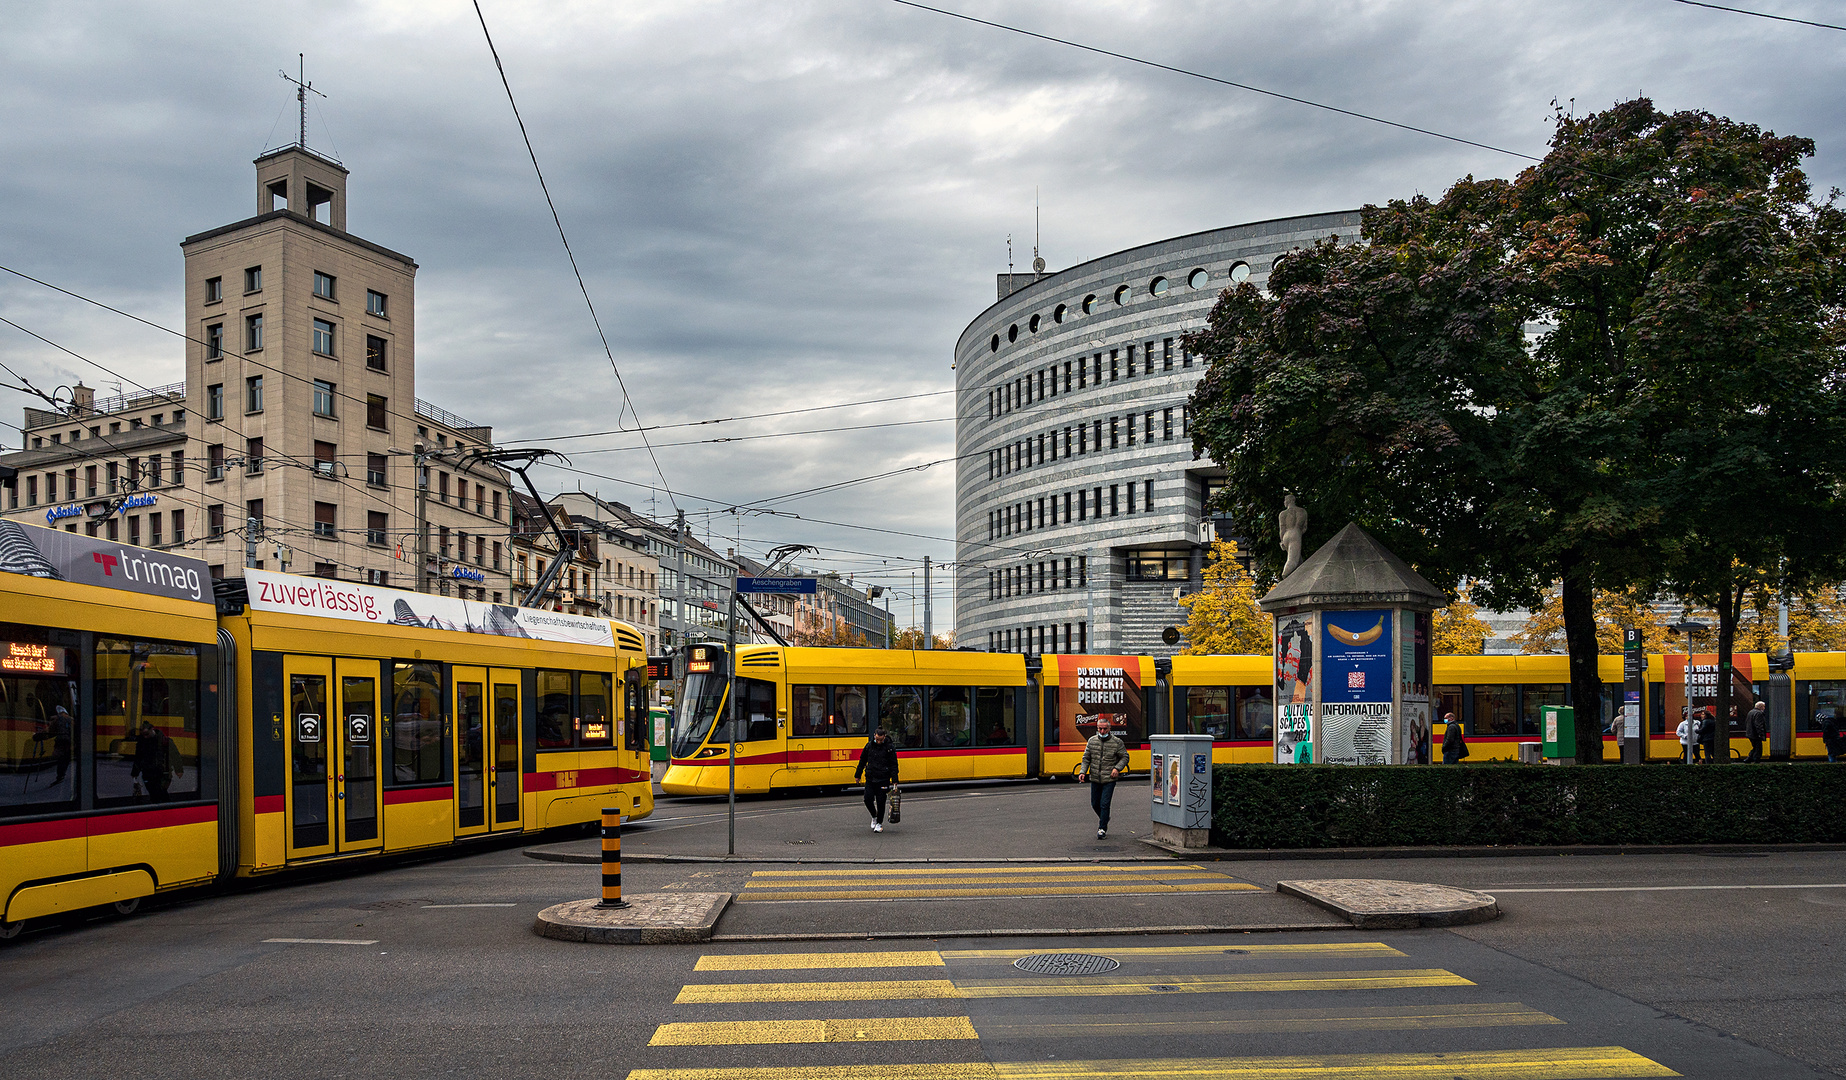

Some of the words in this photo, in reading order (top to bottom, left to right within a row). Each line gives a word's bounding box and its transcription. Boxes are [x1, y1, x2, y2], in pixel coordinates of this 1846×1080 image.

[128, 492, 157, 508] Basler
[56, 503, 83, 519] Basler
[120, 549, 201, 601] trimag
[463, 566, 485, 582] Basler
[751, 578, 802, 588] Aeschengraben
[257, 581, 382, 620] zuverlässig.
[1628, 630, 1635, 641] B
[1077, 667, 1087, 676] DU
[1088, 667, 1103, 676] BIST
[1104, 667, 1124, 676] NICHT
[1696, 665, 1711, 673] BIST
[1077, 677, 1124, 690] PERFEKT?
[1077, 691, 1124, 704] PERFEKT!
[1322, 703, 1390, 715] INFORMATION
[1279, 716, 1306, 729] SCAPES
[1293, 729, 1311, 742] 2021
[830, 749, 852, 761] BLT
[555, 770, 579, 788] BLT
